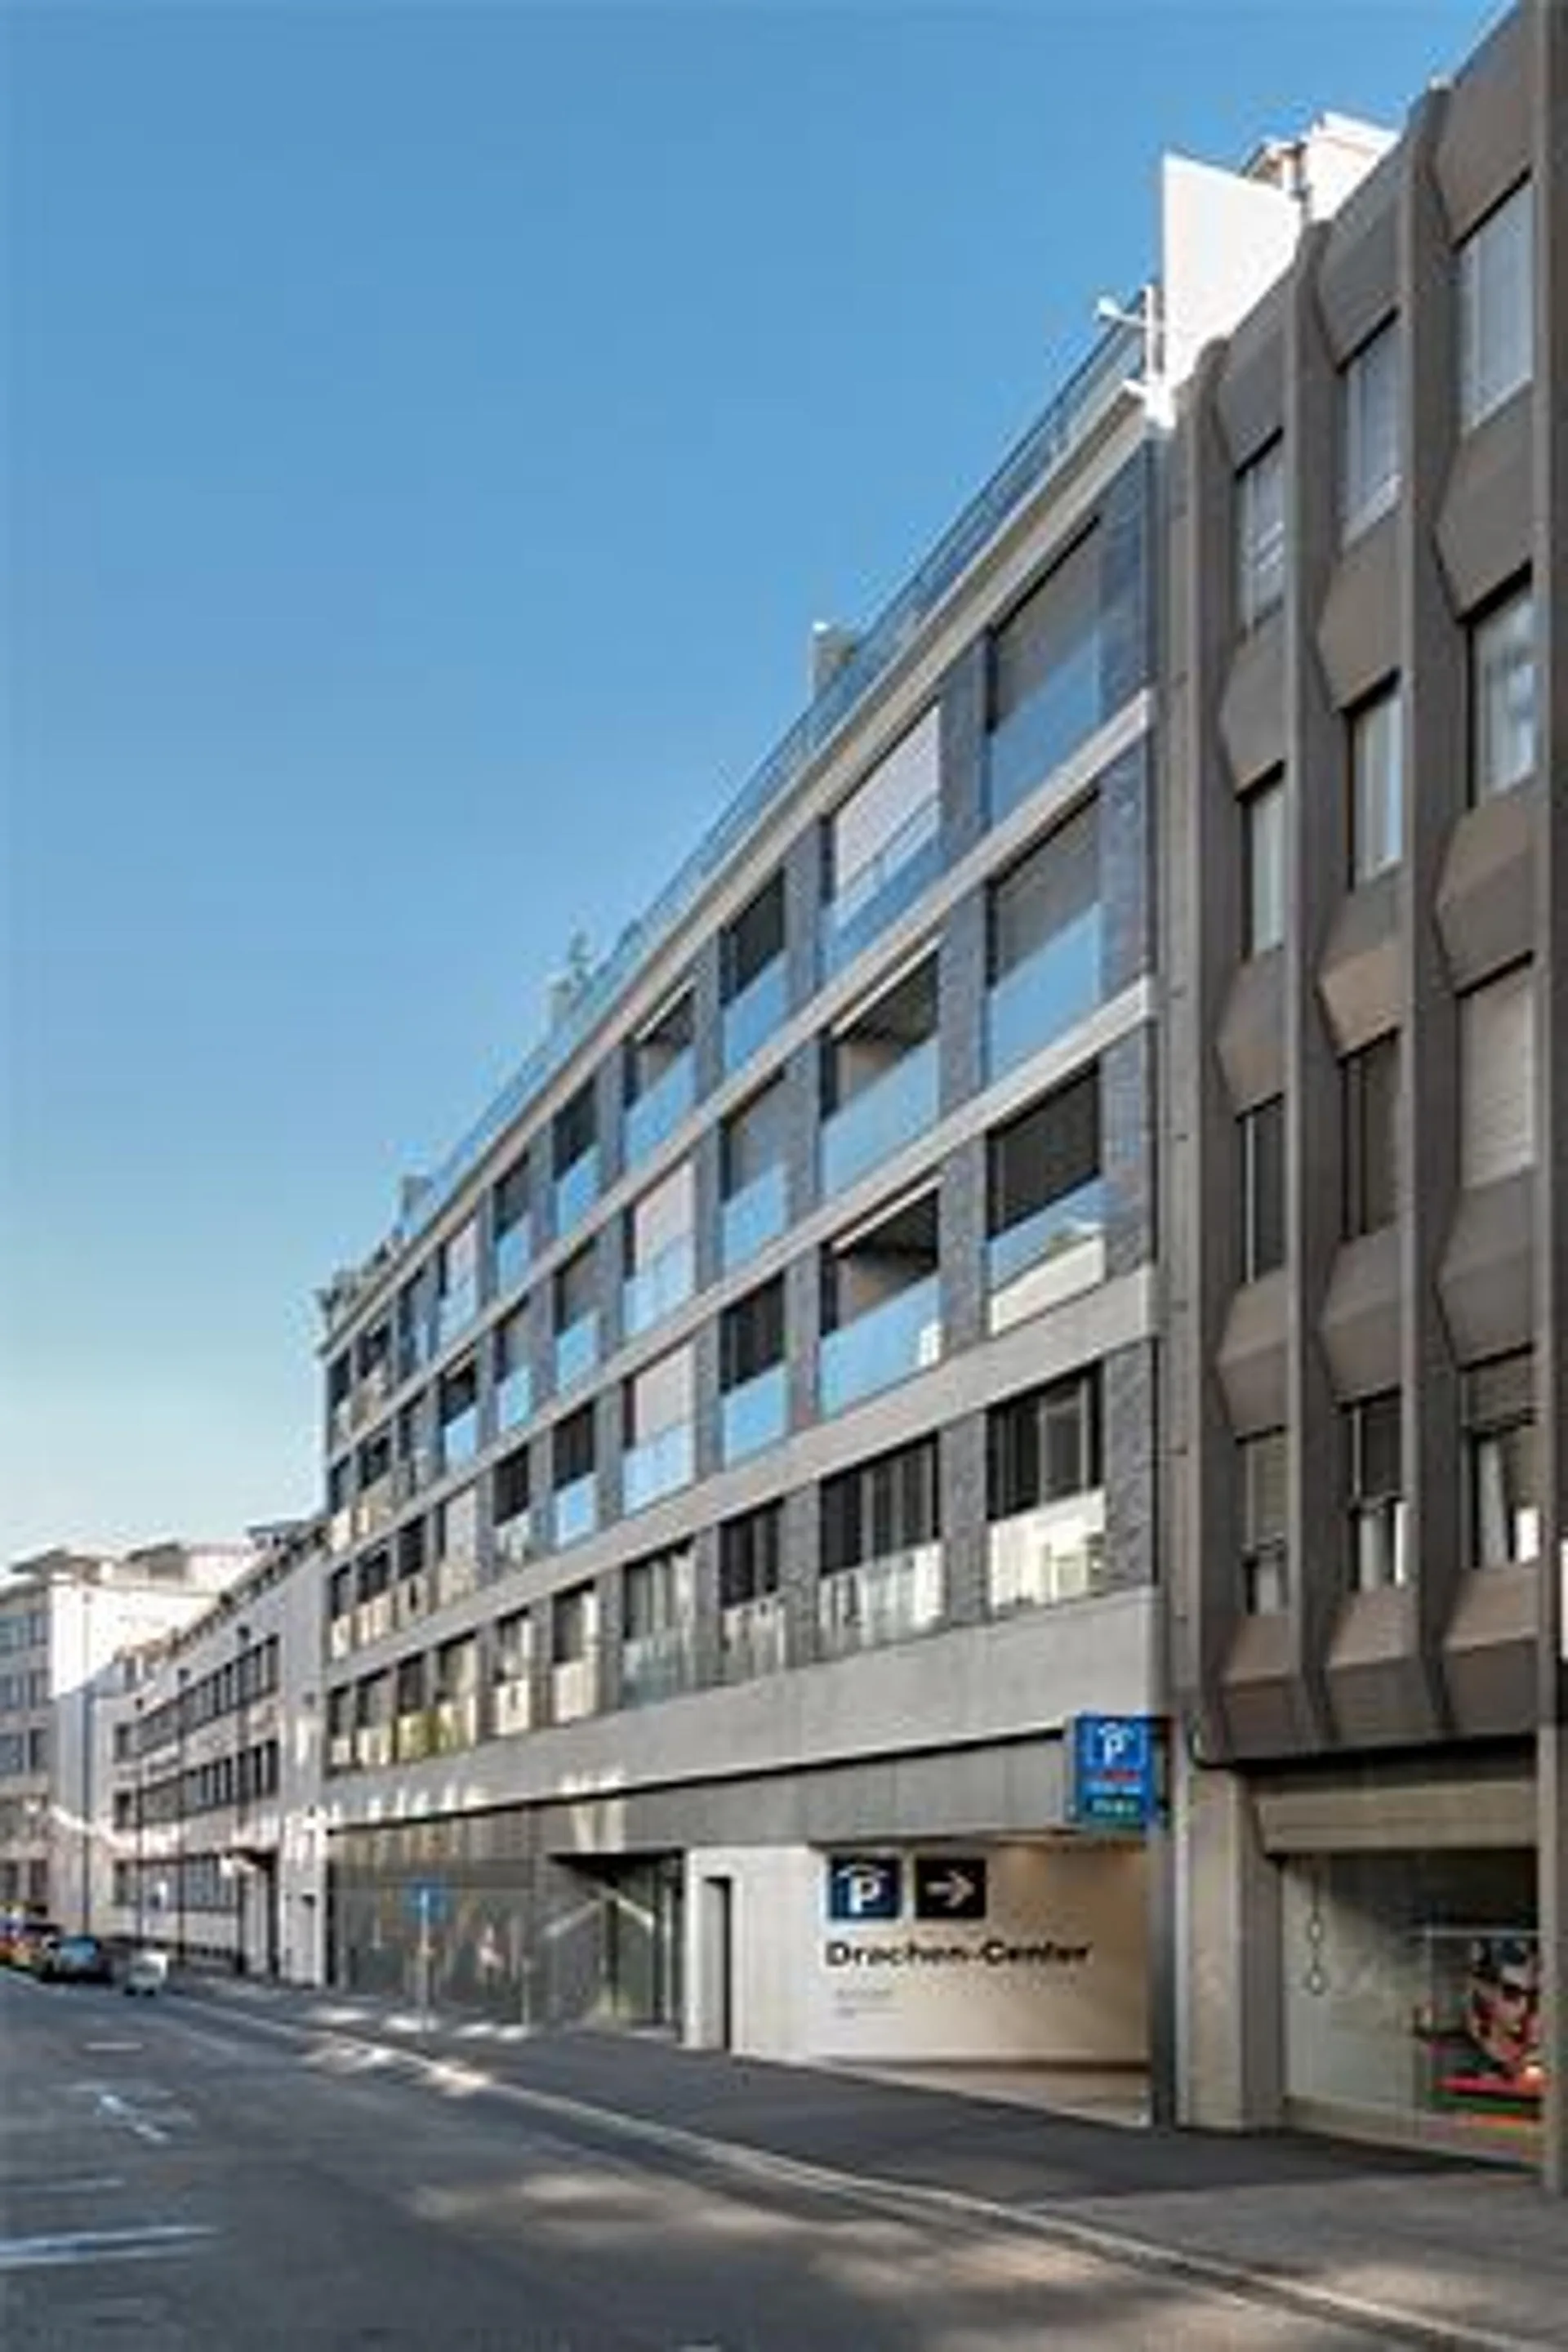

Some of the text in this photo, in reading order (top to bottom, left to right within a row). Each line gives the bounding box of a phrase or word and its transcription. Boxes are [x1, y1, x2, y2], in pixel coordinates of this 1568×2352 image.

[1104, 1733, 1124, 1766] P
[849, 1876, 880, 1913] P
[826, 1939, 1092, 1967] Drachen-Center
